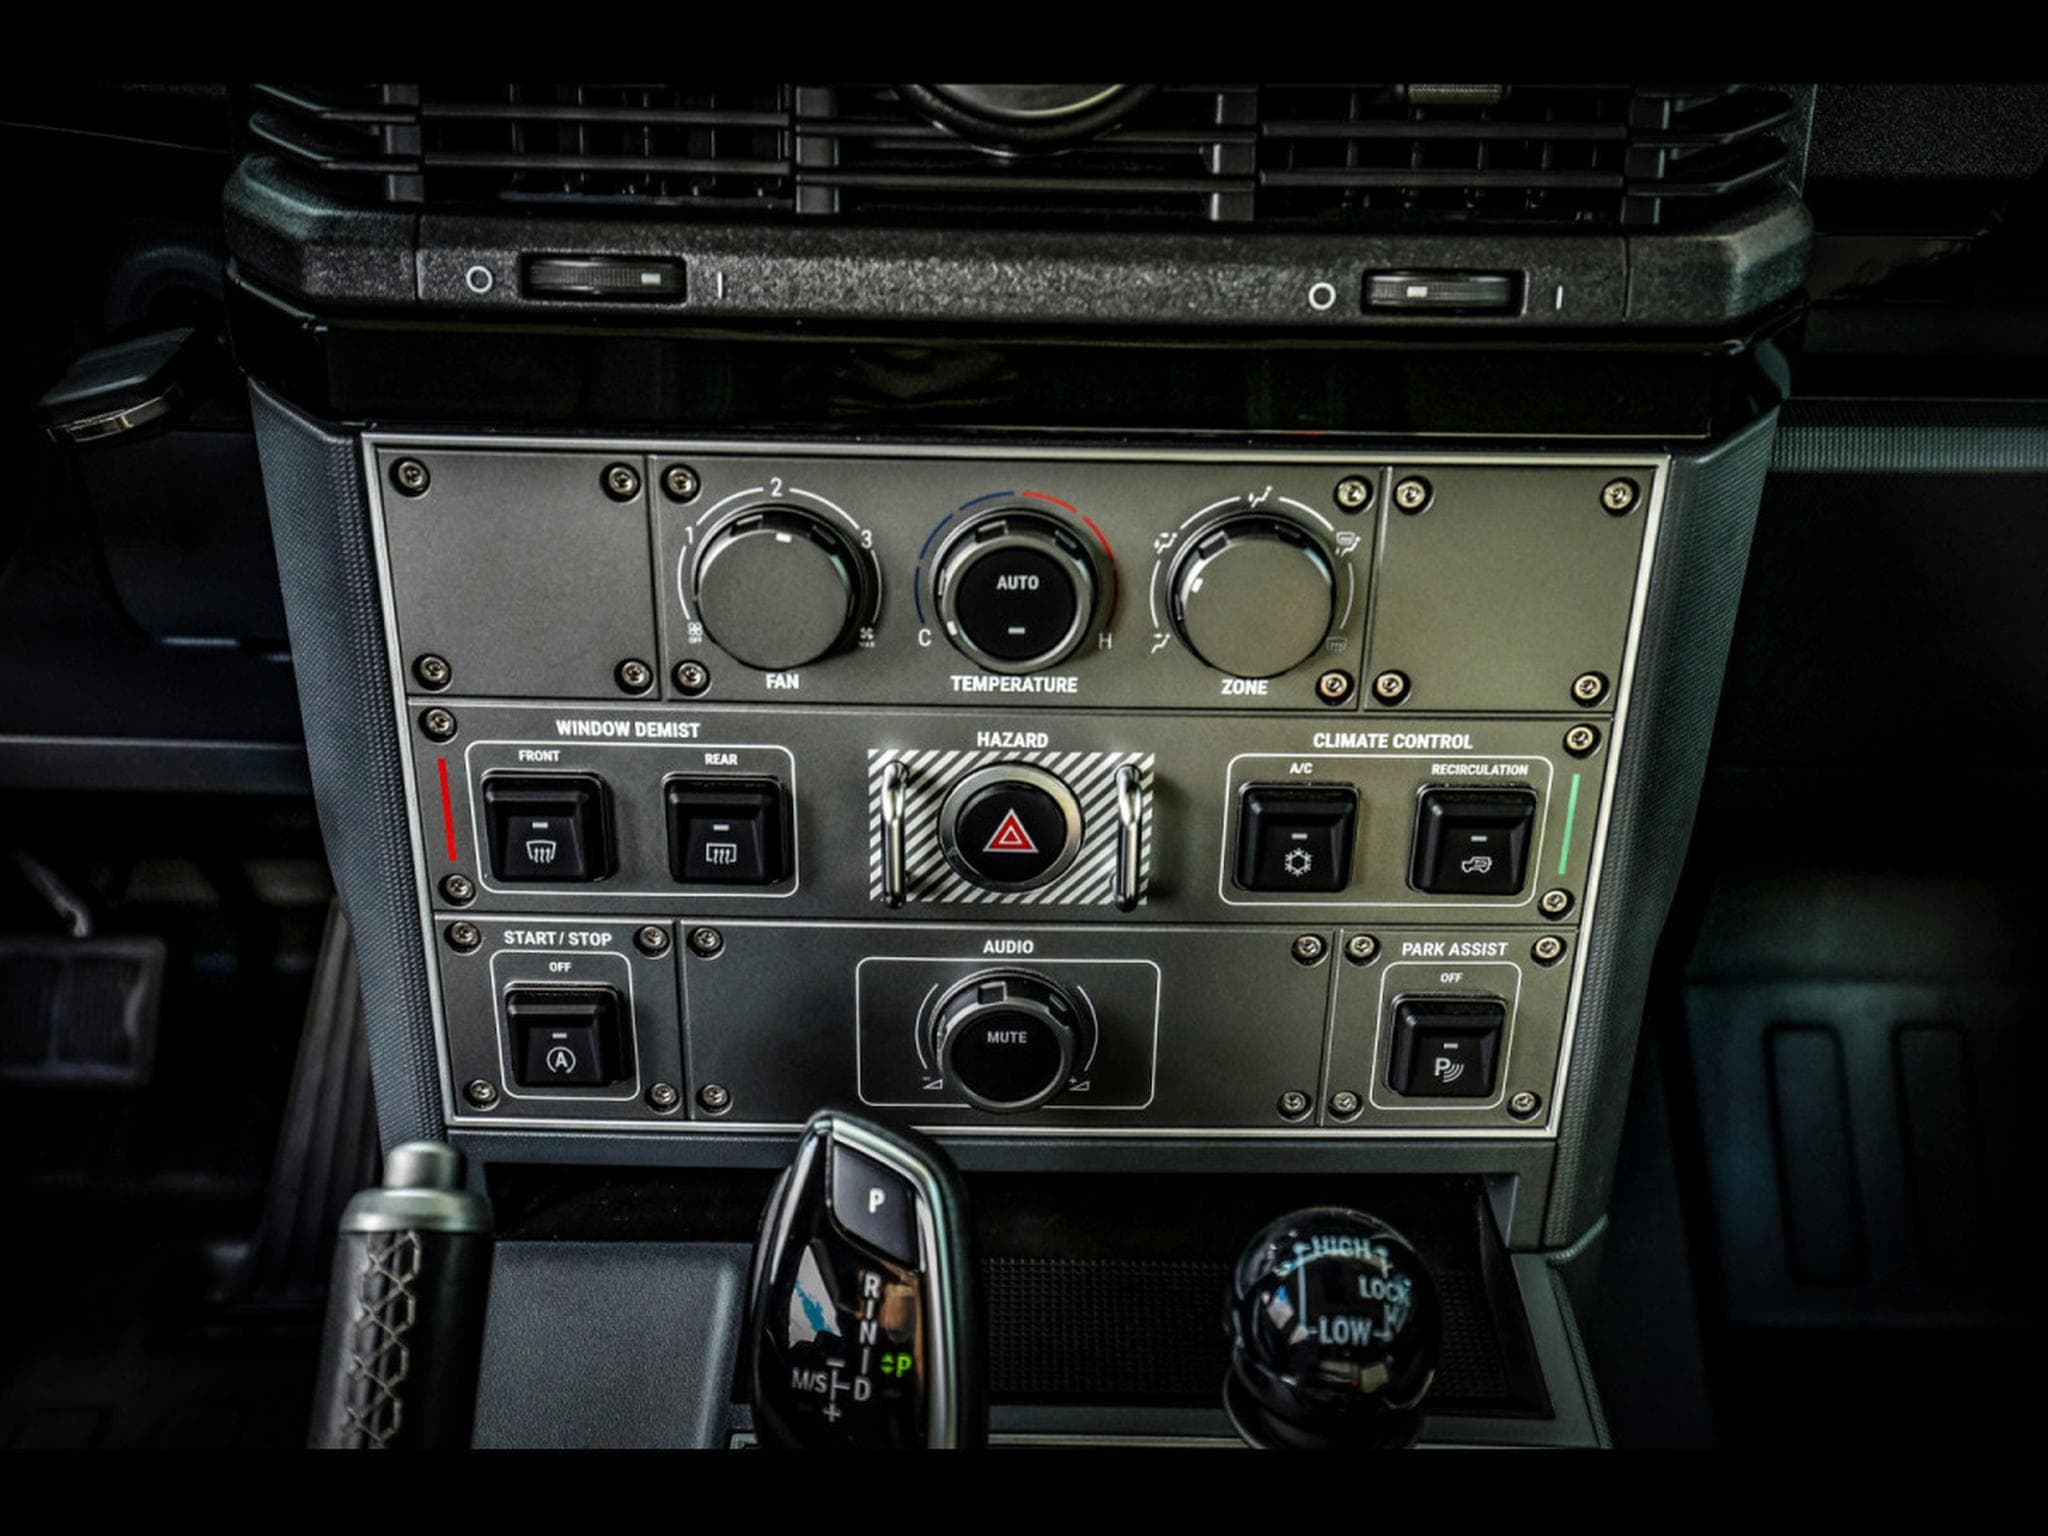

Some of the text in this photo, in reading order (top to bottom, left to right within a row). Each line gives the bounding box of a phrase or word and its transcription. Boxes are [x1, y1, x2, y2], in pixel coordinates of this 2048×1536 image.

[771, 477, 782, 496] 2
[685, 527, 695, 545] 1
[861, 530, 873, 548] 3
[997, 575, 1039, 589] AUTO
[919, 629, 931, 646] C
[1100, 634, 1112, 649] H
[766, 674, 799, 689] FAN
[950, 675, 1078, 693] TEMPERATURE
[1221, 679, 1268, 695] ZONE
[556, 720, 700, 738] WINDOW DEMIST
[976, 731, 1049, 749] HAZARD
[1312, 733, 1474, 751] CLIMATE CONTROL
[519, 750, 560, 761] FRONT
[705, 753, 737, 765] REAR
[1290, 763, 1312, 773] A/C
[1432, 764, 1528, 775] RECIRCULATION
[983, 940, 1033, 953] AUDIO
[1402, 942, 1508, 956] PARK ASSIST
[549, 962, 571, 972] OFF
[1440, 973, 1462, 982] OFF
[988, 1031, 1026, 1043] MUTE
[869, 1189, 884, 1213] P
[1311, 1235, 1370, 1261] HIGH
[864, 1272, 881, 1298] R
[859, 1320, 877, 1345] N
[1319, 1316, 1372, 1347] LOW
[897, 1355, 911, 1376] P
[793, 1370, 826, 1392] M/S
[855, 1378, 870, 1400] D
